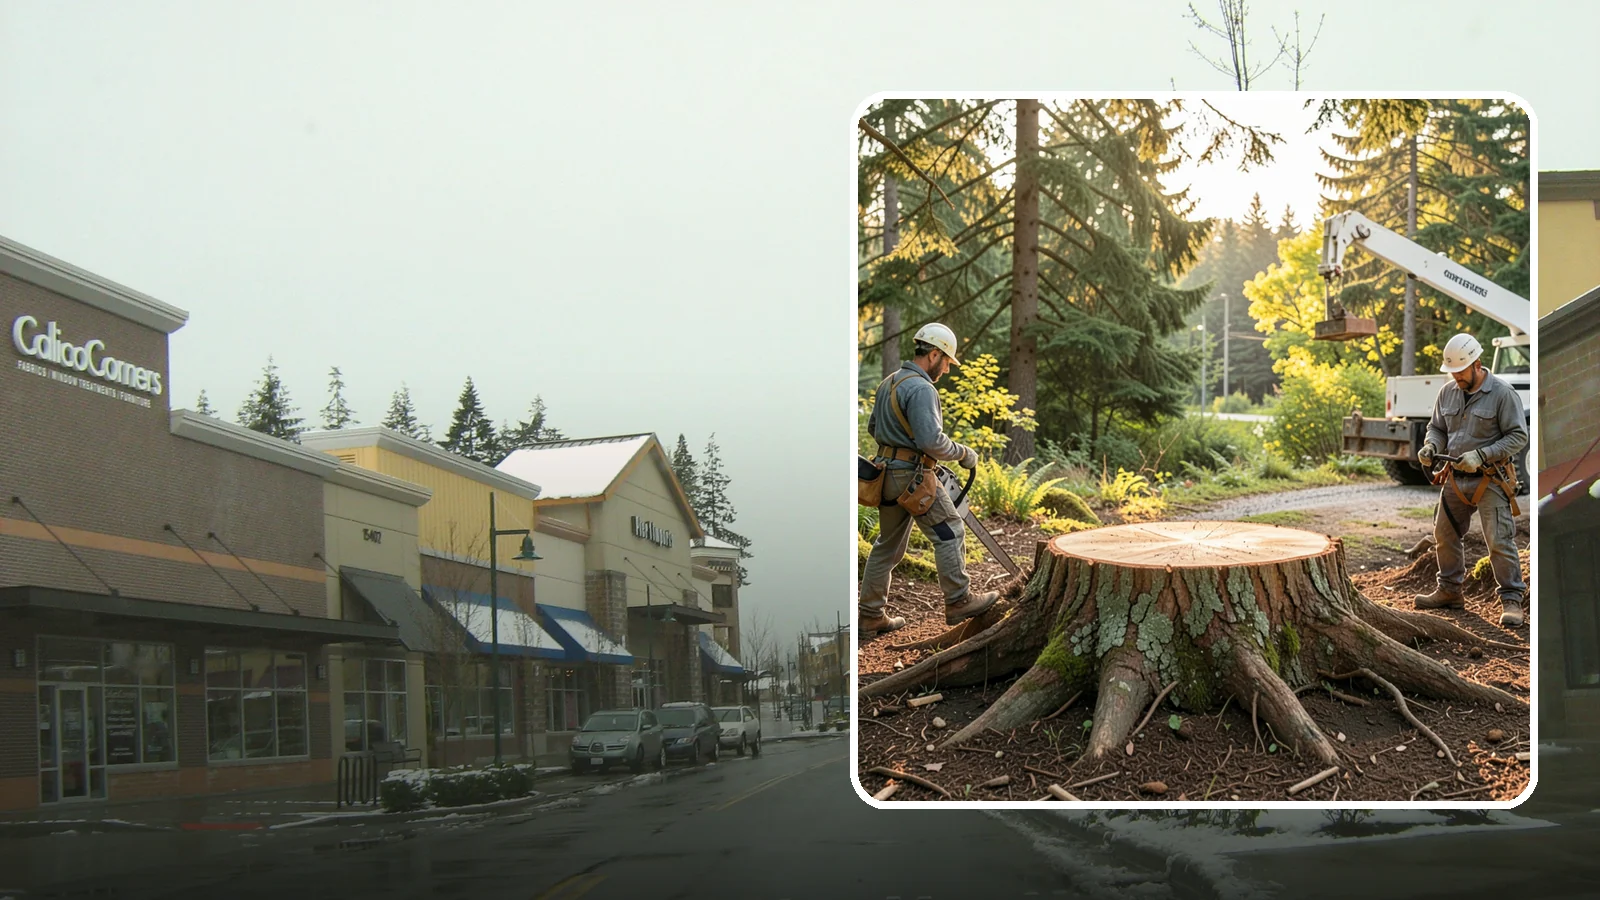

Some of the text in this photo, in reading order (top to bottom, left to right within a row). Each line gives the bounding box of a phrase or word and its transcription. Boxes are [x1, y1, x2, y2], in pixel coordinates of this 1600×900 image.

[17, 360, 151, 408] FABRICS WINDOW TREATMENTS FURNITURE
